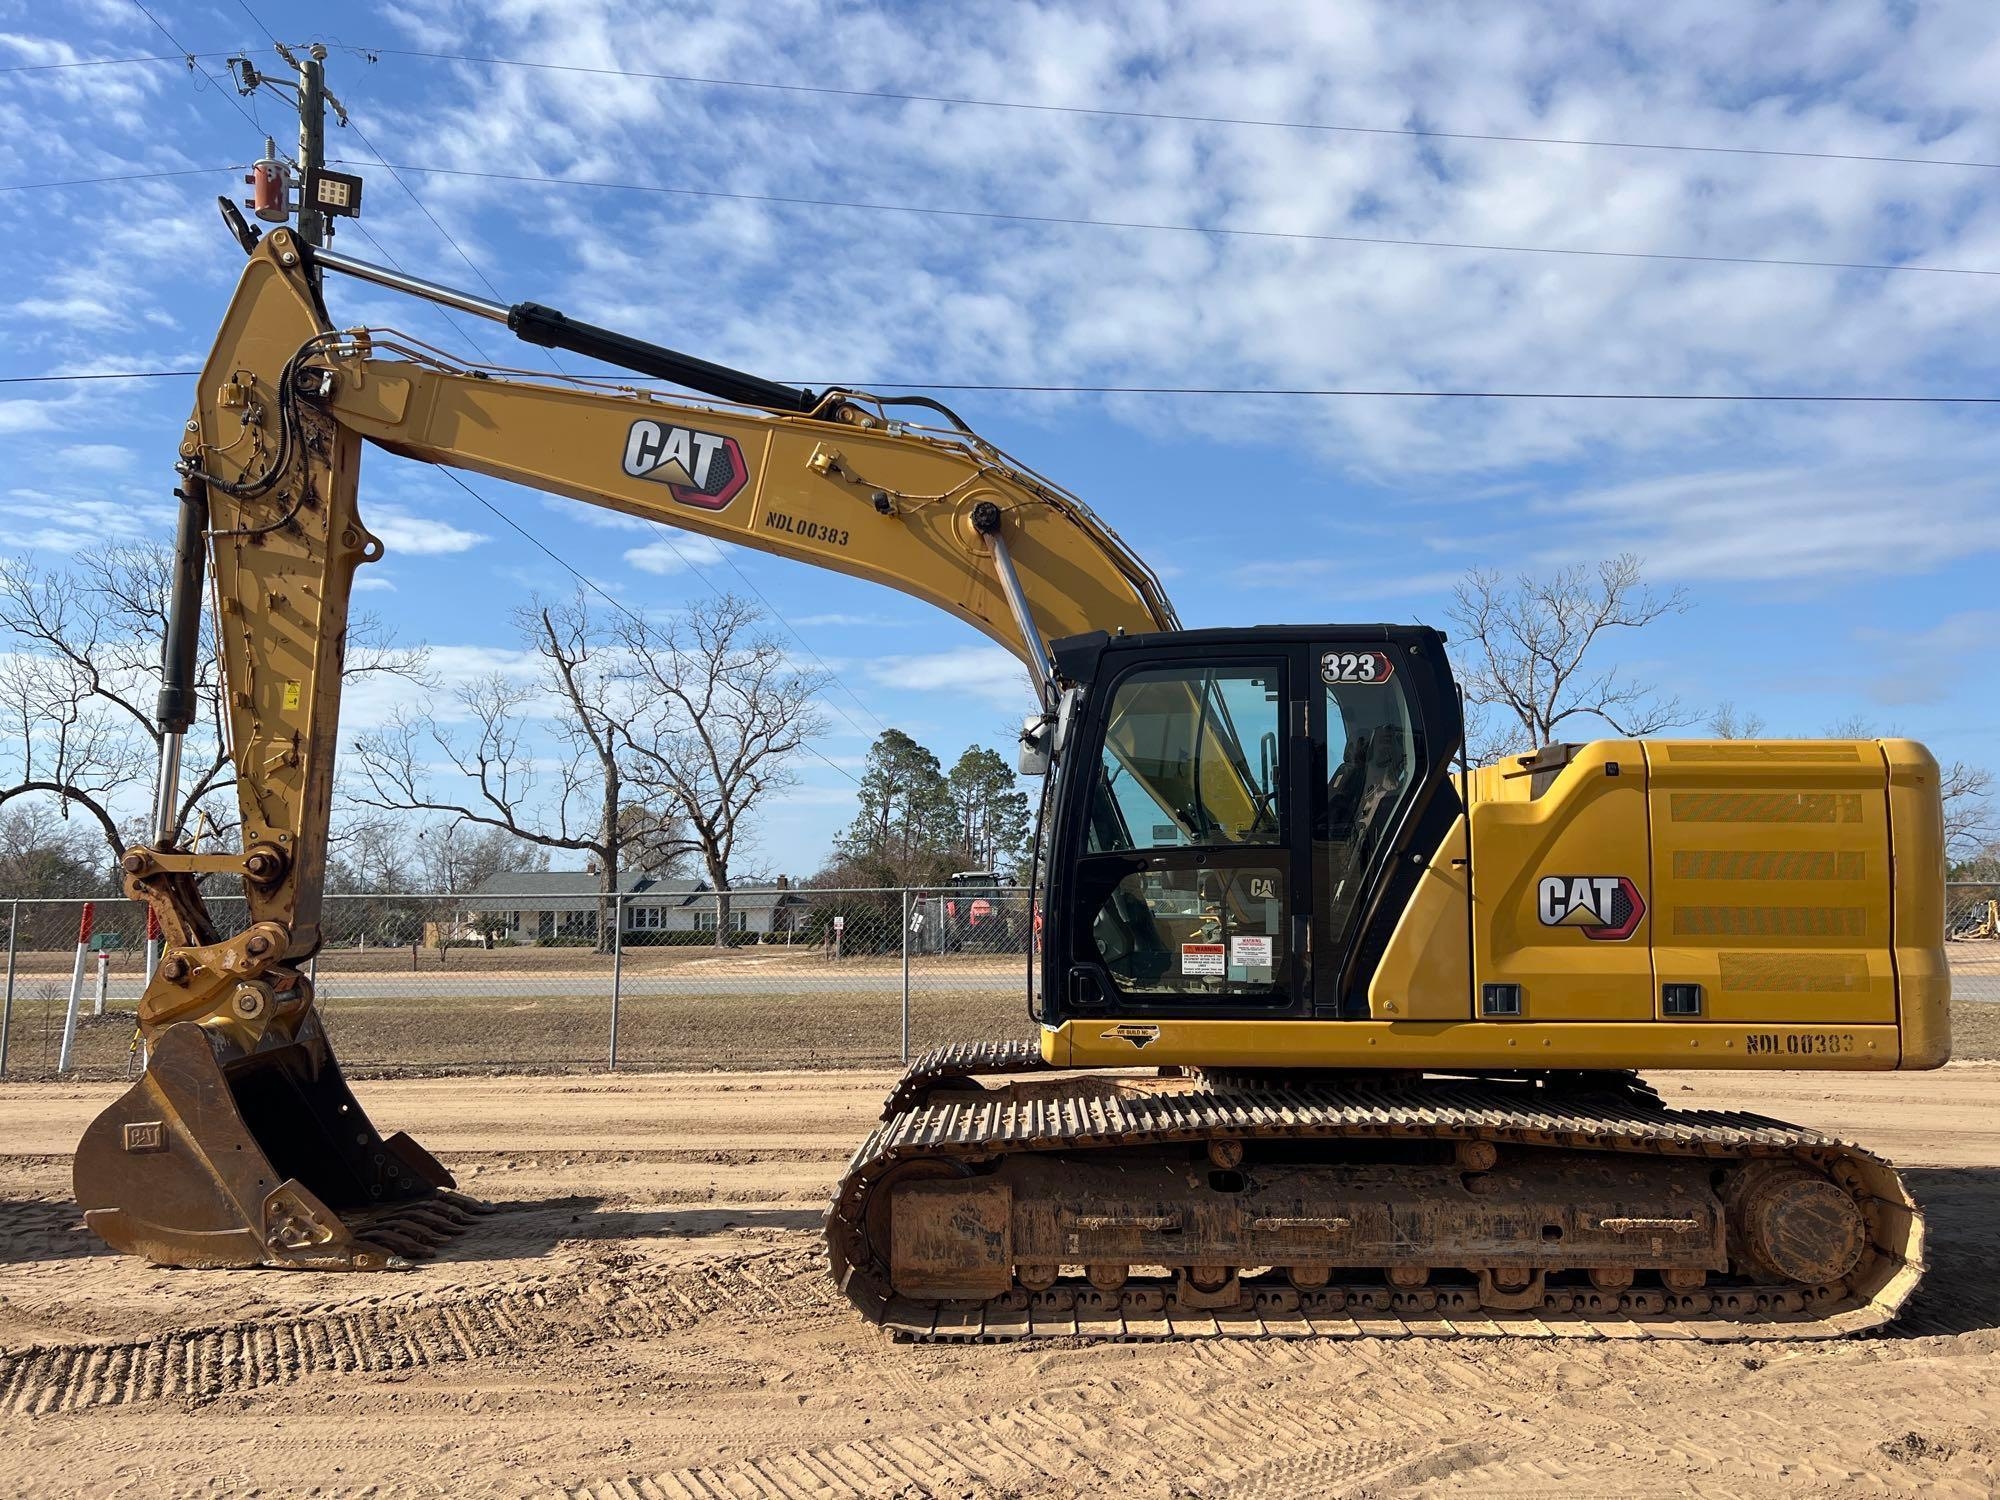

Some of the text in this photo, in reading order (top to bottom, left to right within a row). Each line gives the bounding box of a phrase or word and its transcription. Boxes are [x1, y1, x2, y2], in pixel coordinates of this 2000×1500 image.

[624, 420, 724, 490] CAT
[765, 511, 849, 546] NDL00383
[1323, 653, 1376, 681] 323
[1250, 878, 1275, 898] CA
[1539, 877, 1619, 925] CAT
[1746, 1034, 1854, 1055] NDL00383
